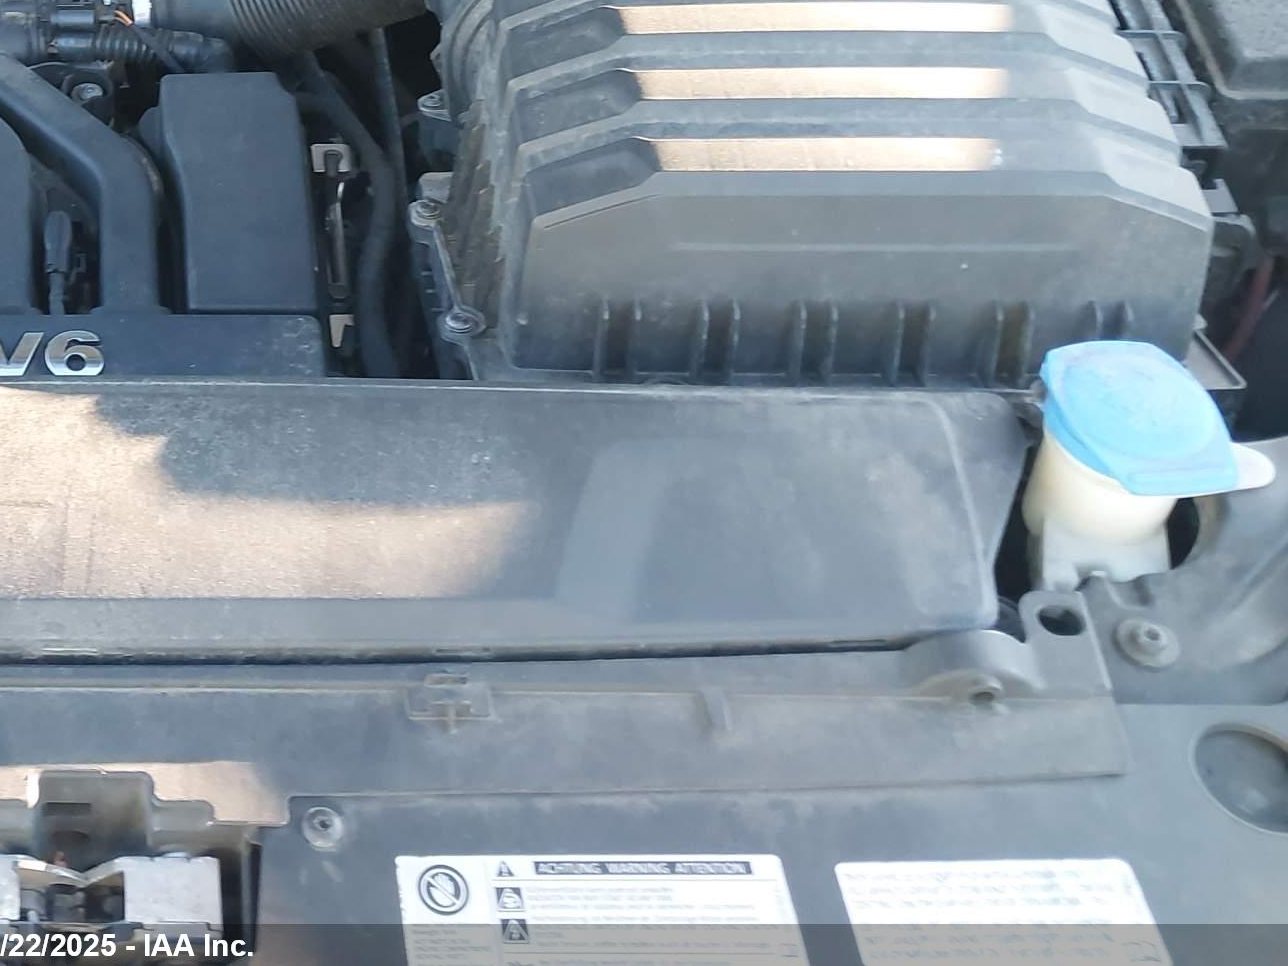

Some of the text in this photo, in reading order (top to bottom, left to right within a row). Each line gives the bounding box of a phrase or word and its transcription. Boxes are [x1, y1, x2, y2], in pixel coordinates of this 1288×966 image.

[538, 862, 746, 874] ACHTUNG WARNING ATTENTION
